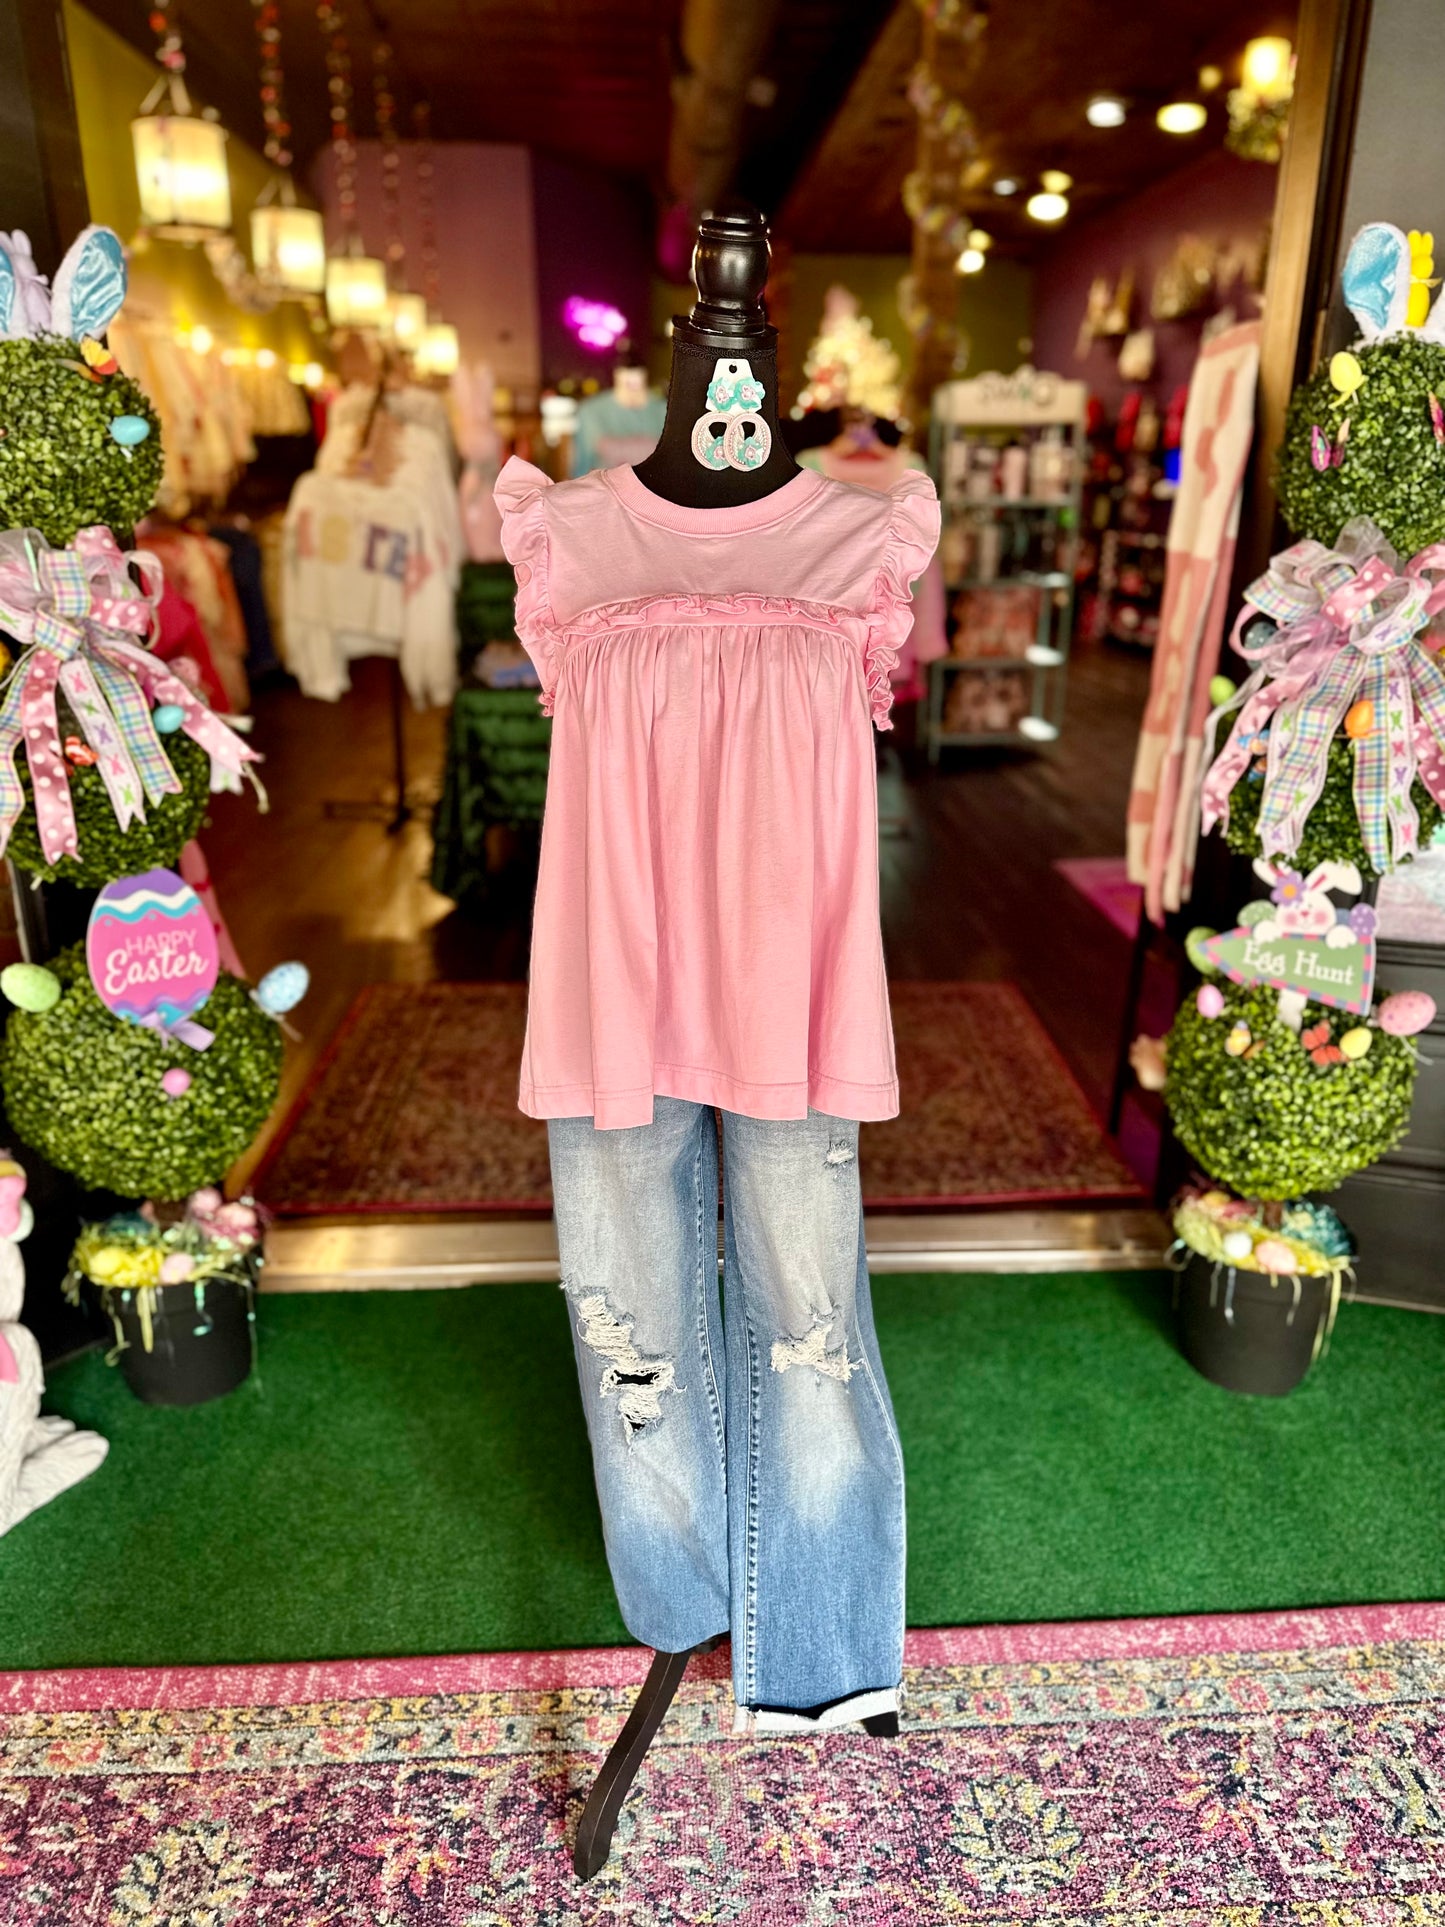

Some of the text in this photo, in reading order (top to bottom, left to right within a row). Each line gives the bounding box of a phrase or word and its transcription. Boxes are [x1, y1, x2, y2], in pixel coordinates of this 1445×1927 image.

[125, 929, 197, 957] HAPPY
[1243, 939, 1355, 985] Egg Hunt
[104, 947, 209, 996] Easter
